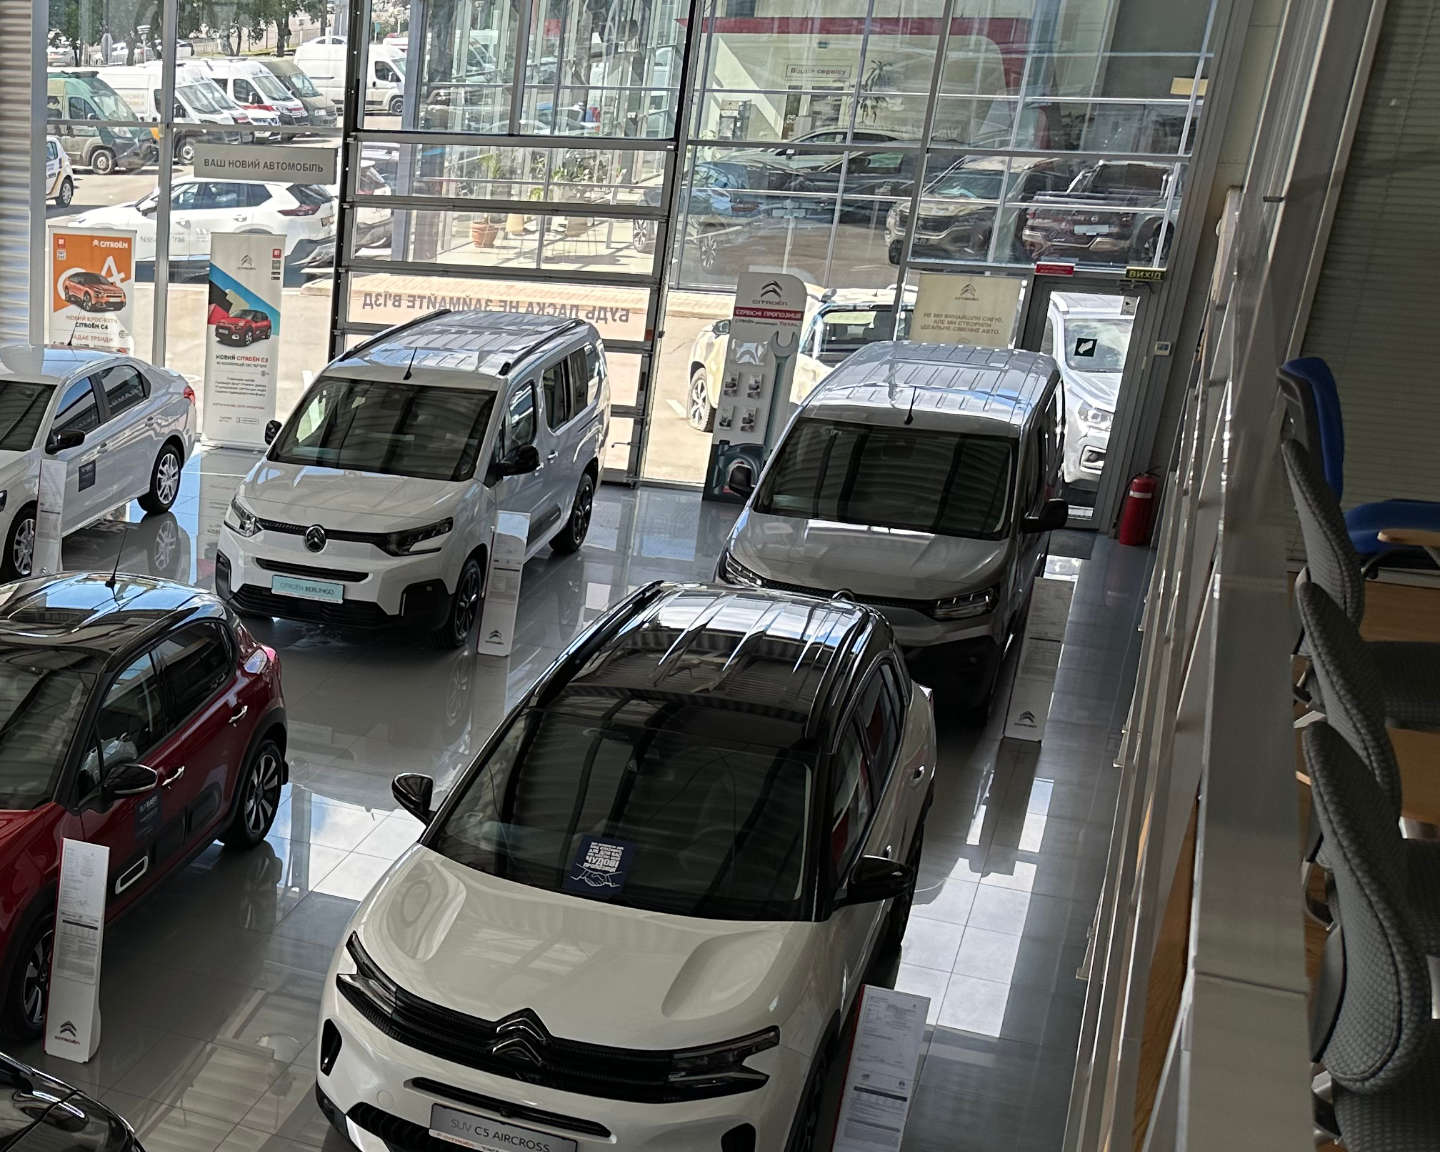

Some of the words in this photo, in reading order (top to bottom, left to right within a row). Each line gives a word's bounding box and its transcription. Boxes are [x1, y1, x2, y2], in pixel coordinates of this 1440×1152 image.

[204, 158, 226, 168] ВАШ
[228, 159, 260, 169] НОВИЙ
[263, 162, 324, 173] АВТОМОБІЛЬ
[1128, 270, 1161, 279] ВИХІД
[474, 1125, 490, 1138] C5
[492, 1130, 551, 1152] AIRCROSS
